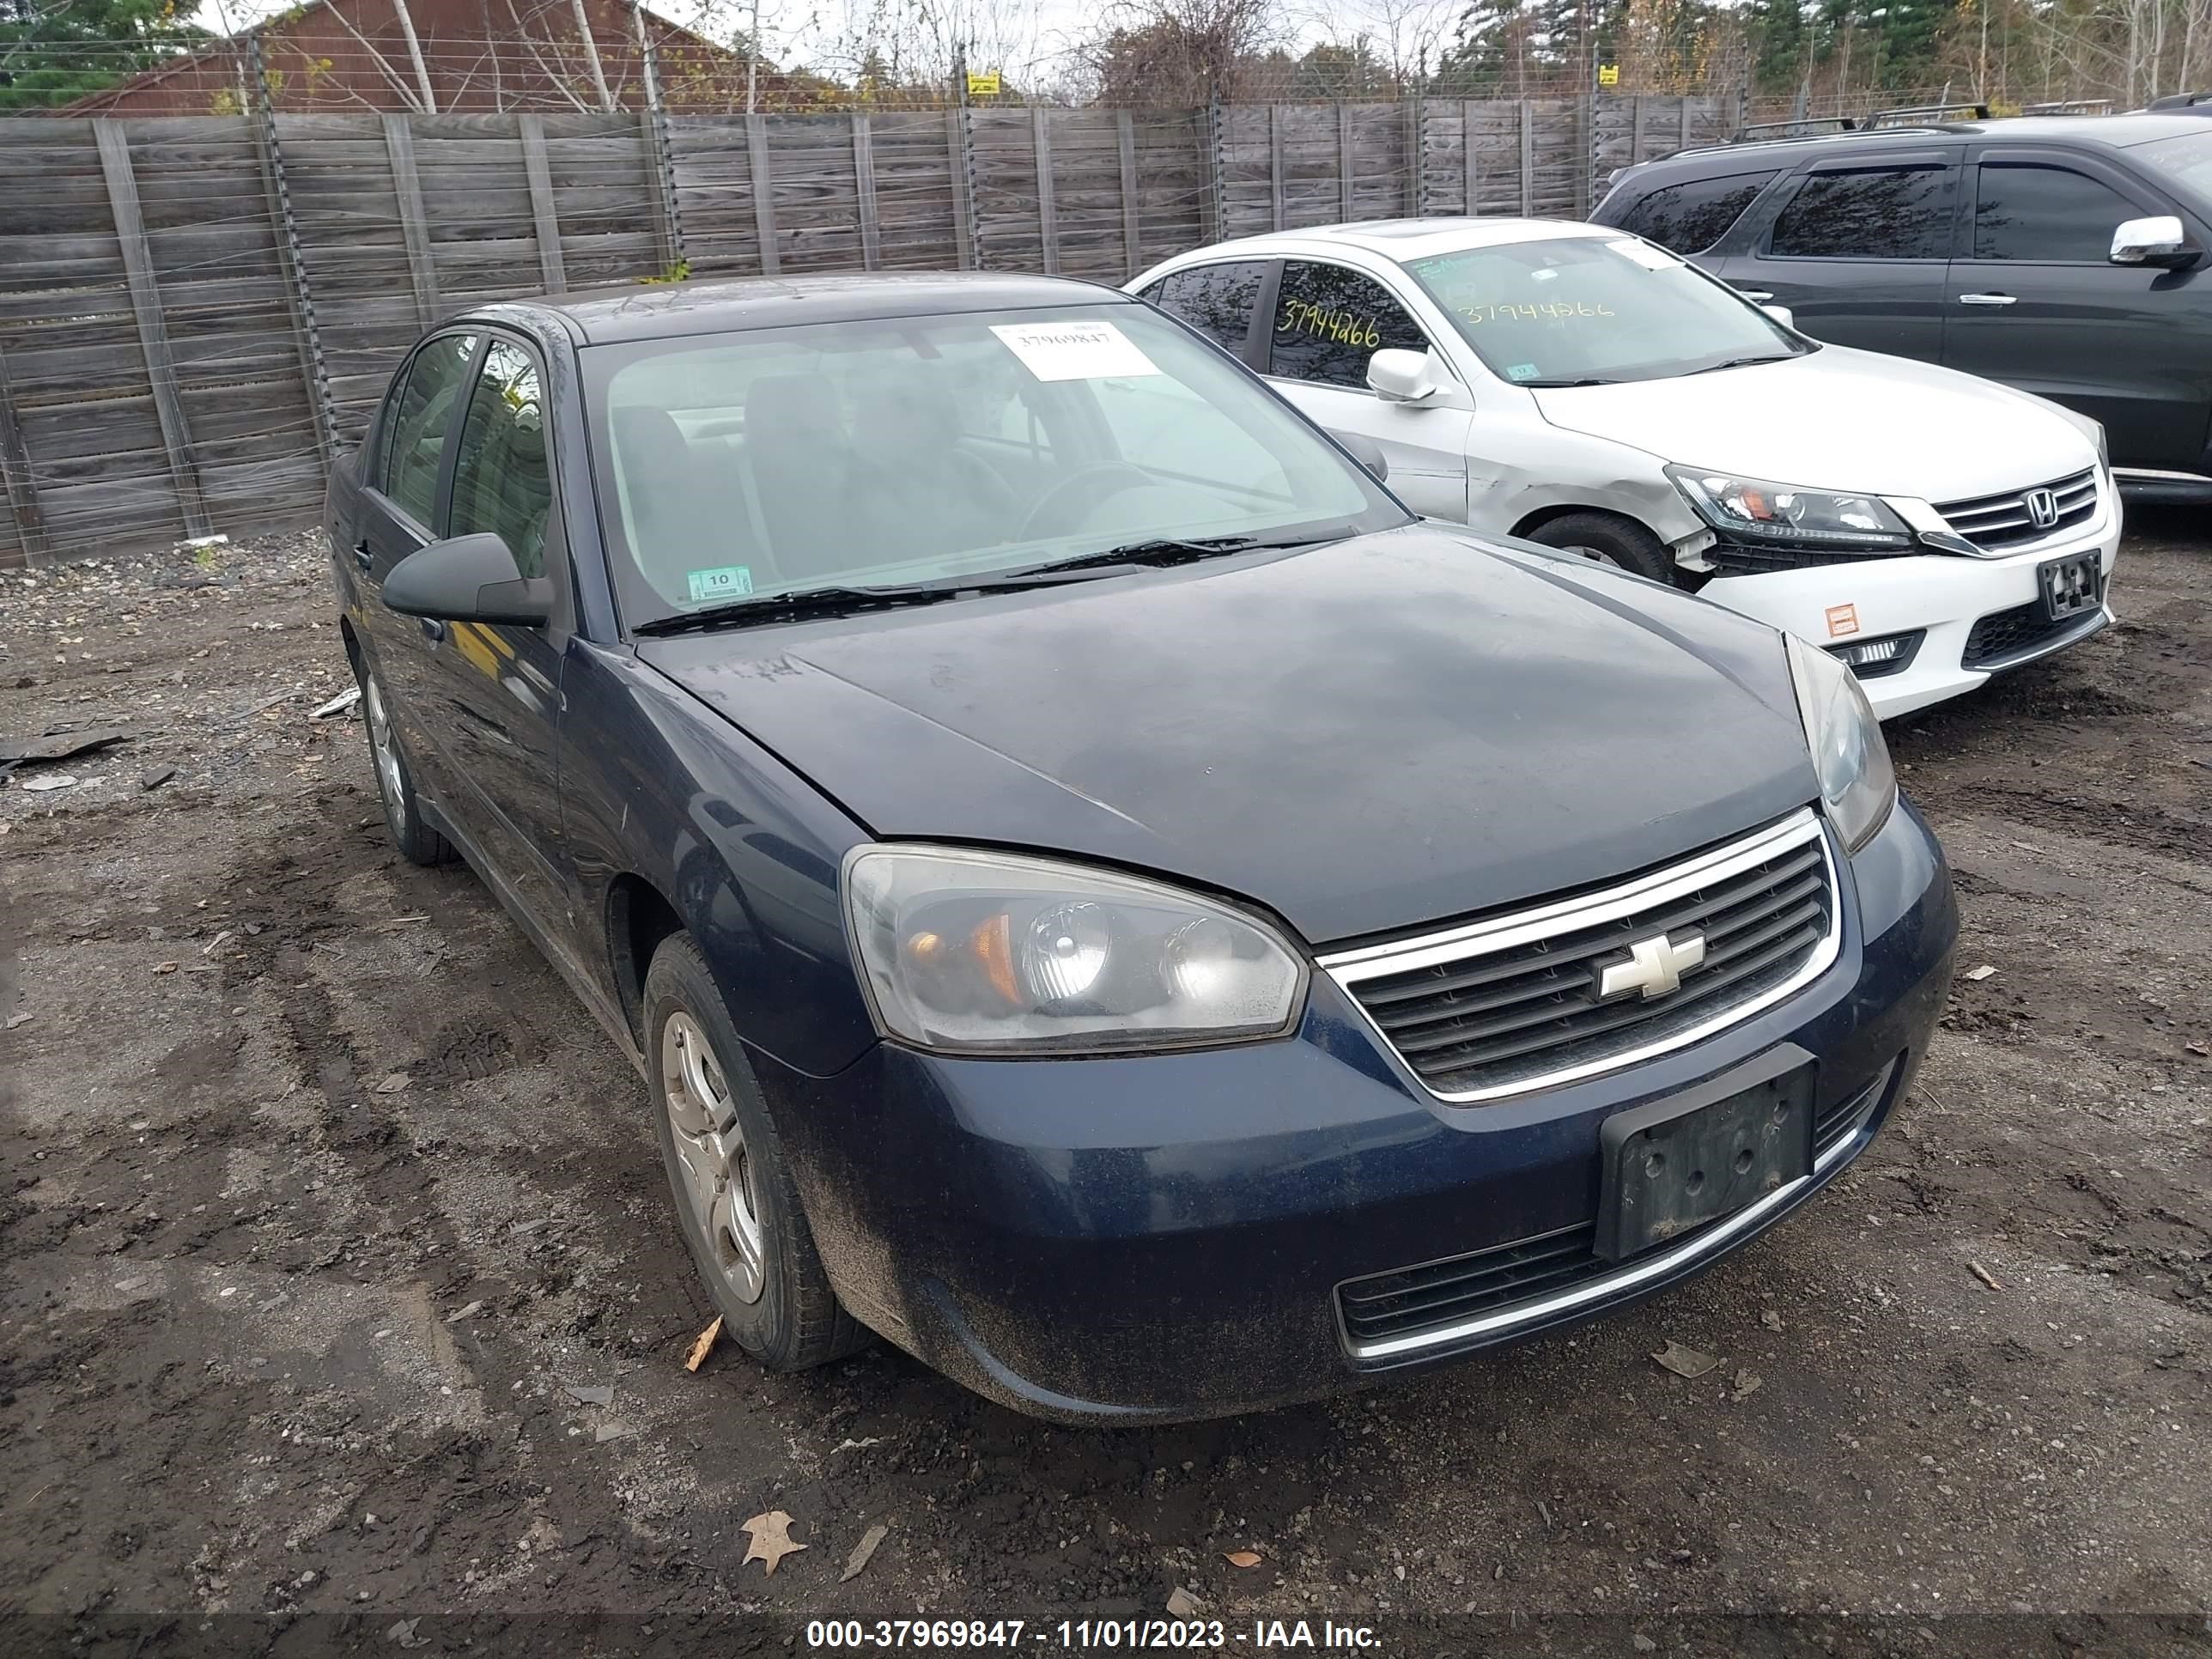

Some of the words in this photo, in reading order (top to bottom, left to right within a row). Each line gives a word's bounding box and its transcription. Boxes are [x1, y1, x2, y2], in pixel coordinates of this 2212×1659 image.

[1278, 300, 1380, 348] 37944266
[1018, 333, 1110, 347] 37969847
[709, 574, 729, 585] 10
